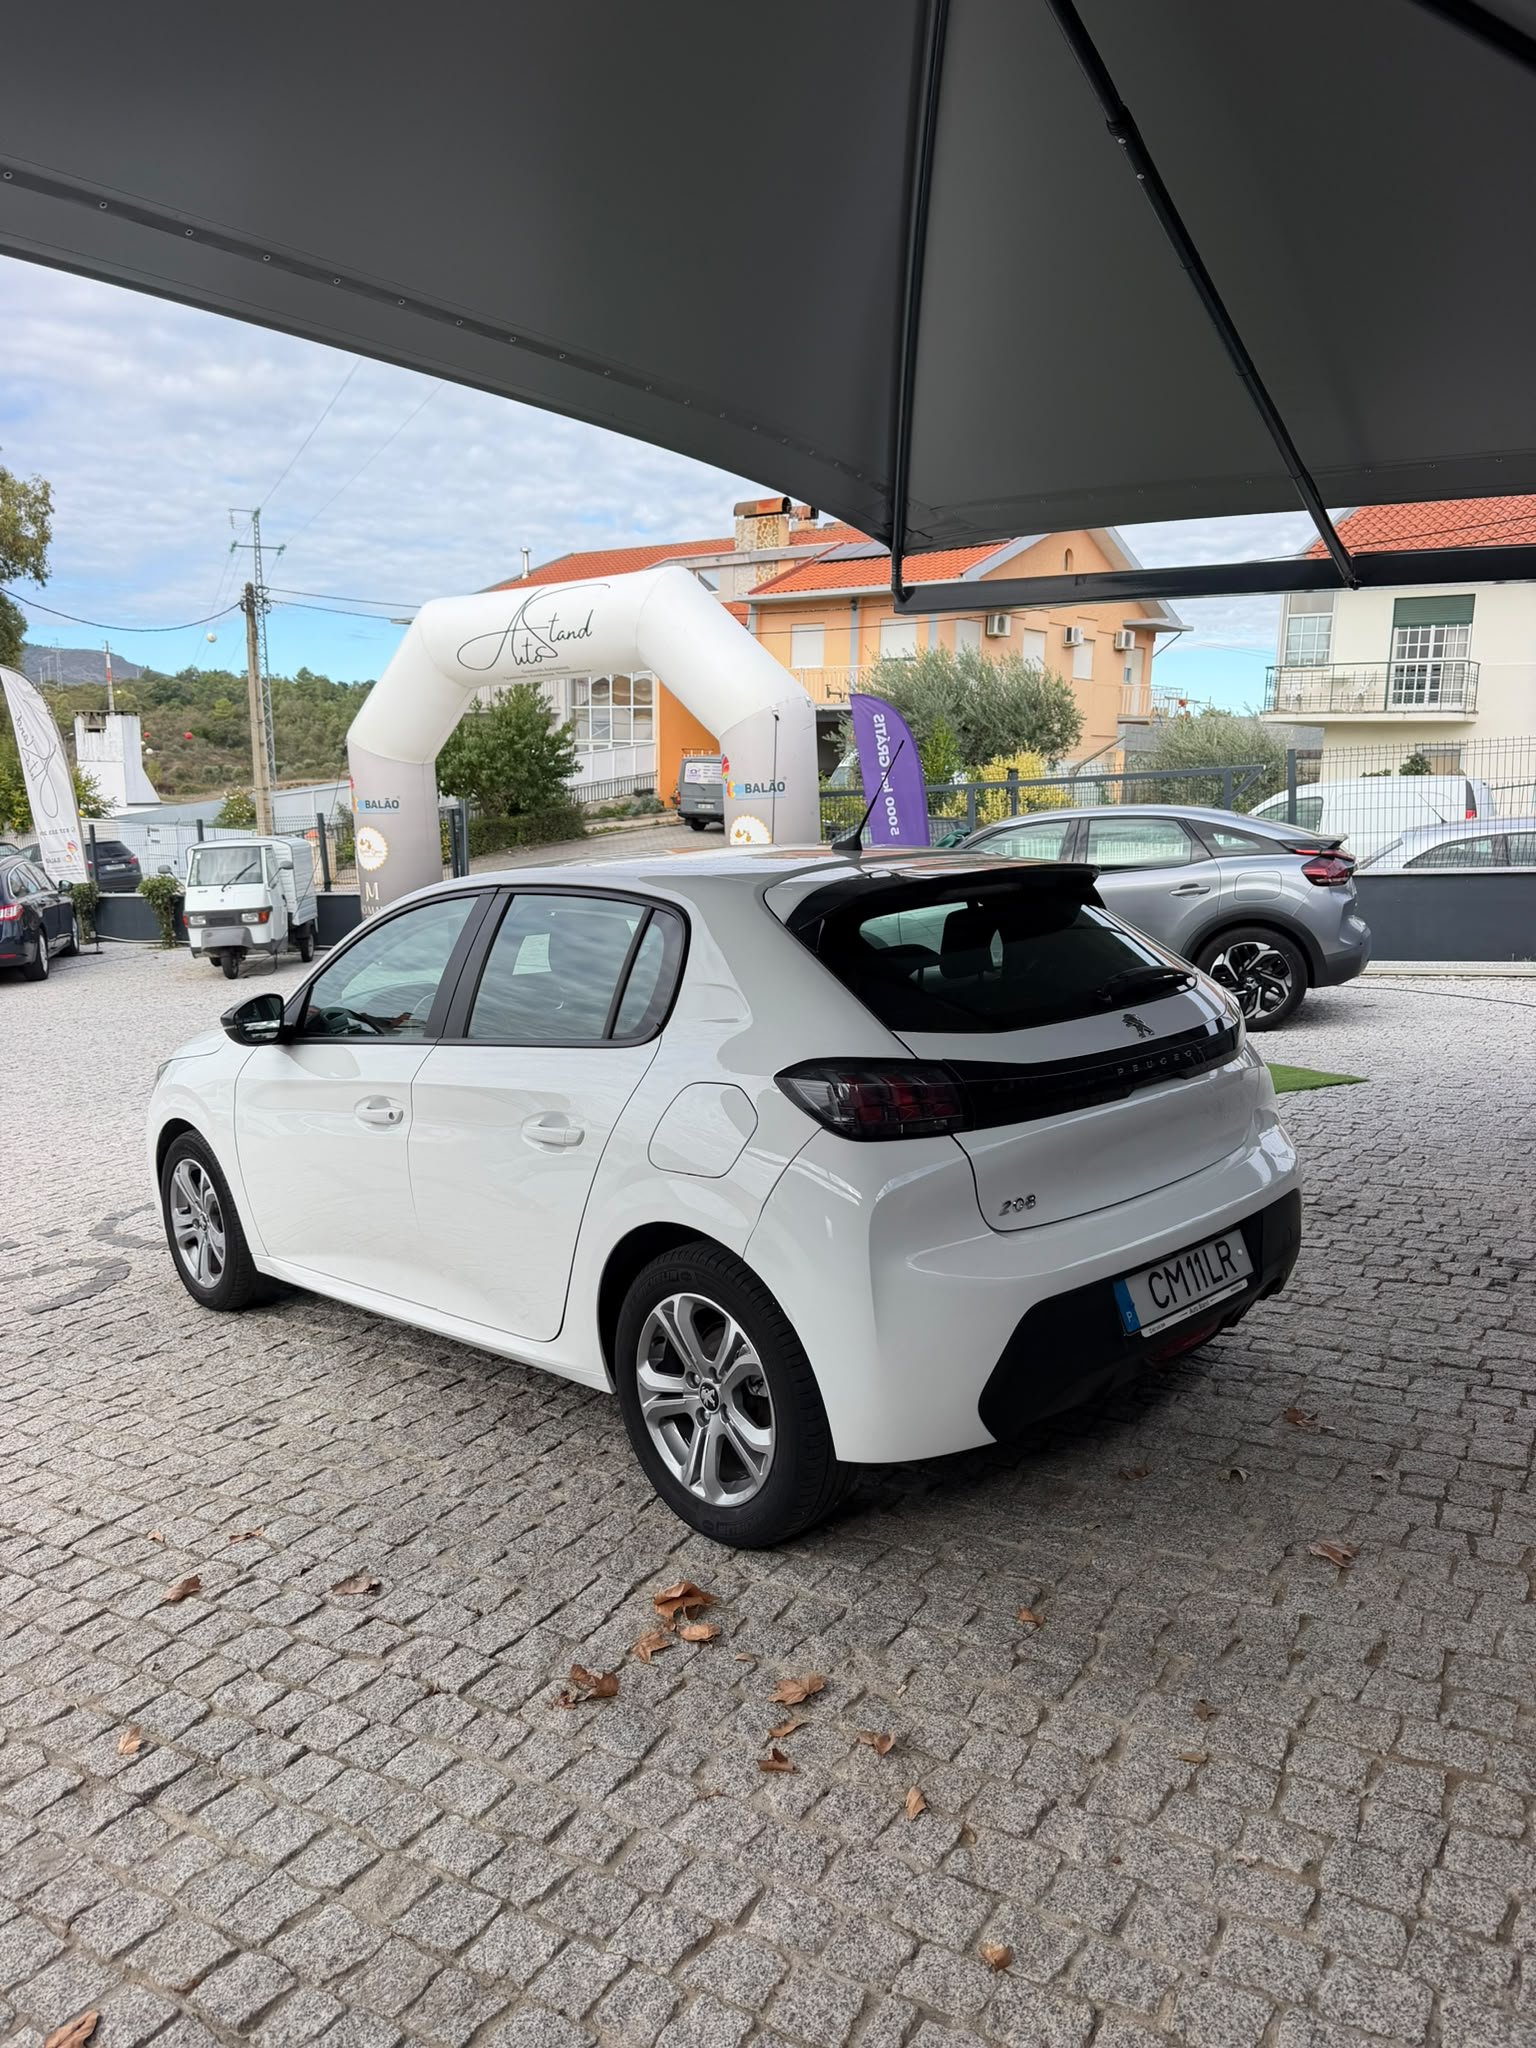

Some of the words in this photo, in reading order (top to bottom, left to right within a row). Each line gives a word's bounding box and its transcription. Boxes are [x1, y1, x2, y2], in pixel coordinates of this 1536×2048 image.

[457, 587, 550, 671] Auto
[522, 583, 611, 659] Stand
[744, 779, 786, 794] BALÃO
[364, 797, 400, 809] BALÃO
[365, 881, 380, 902] M
[998, 1194, 1037, 1217] 208
[1125, 1310, 1133, 1323] P
